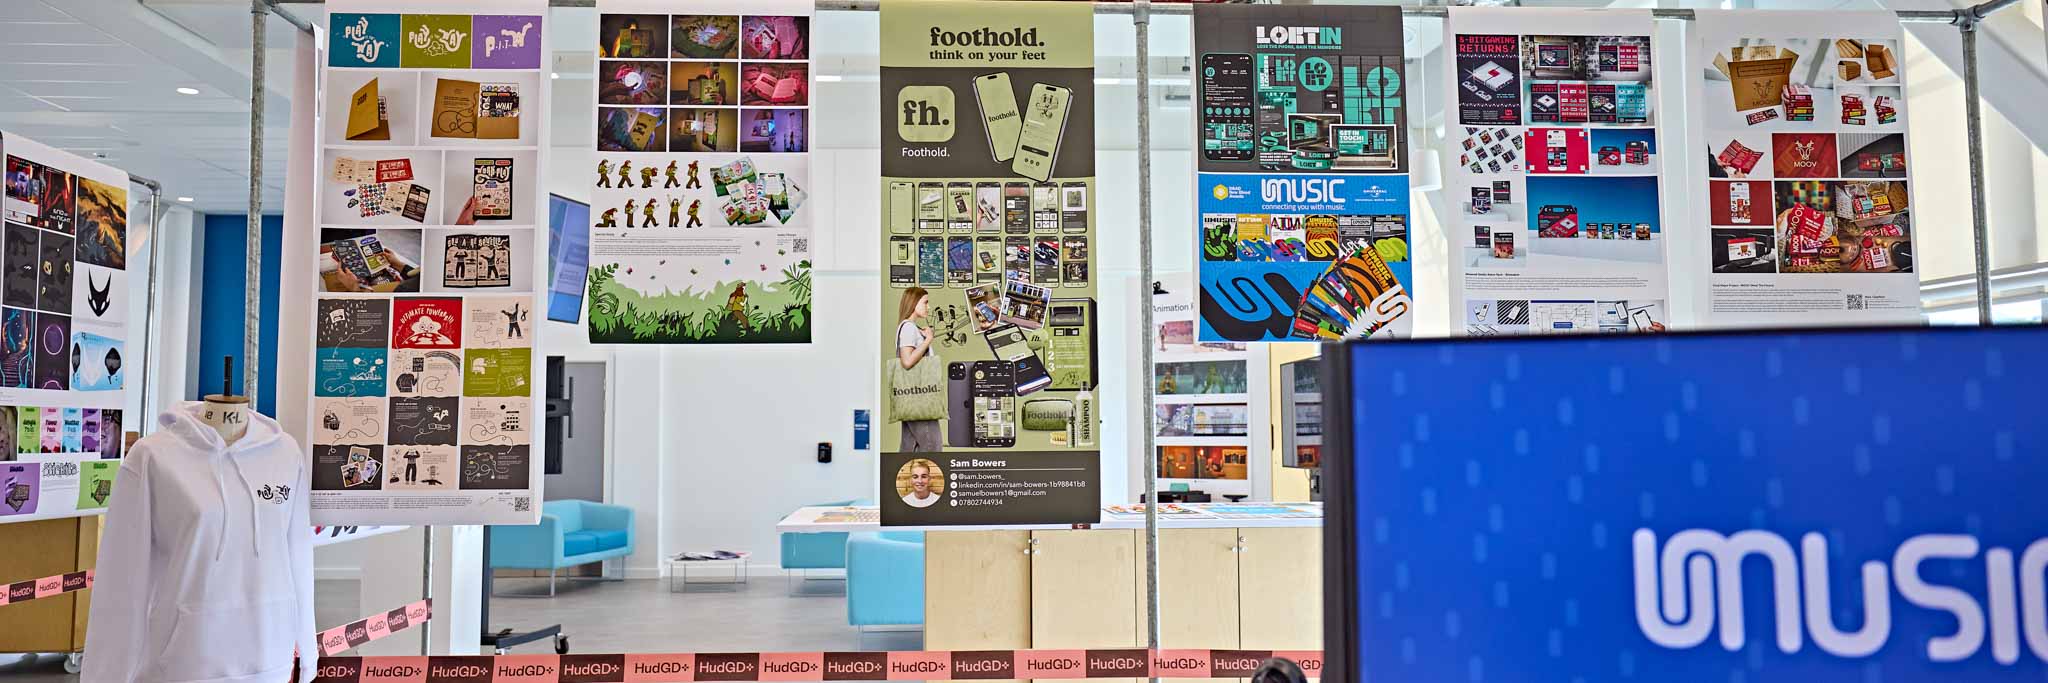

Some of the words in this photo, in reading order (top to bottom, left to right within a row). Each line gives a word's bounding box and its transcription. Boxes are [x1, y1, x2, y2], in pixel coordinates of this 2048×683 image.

[930, 27, 1045, 47] foothold.
[929, 50, 963, 60] think
[968, 52, 984, 60] on
[988, 52, 1018, 62] your
[1022, 50, 1046, 60] feet
[903, 100, 950, 126] fh.
[989, 111, 1018, 123] foothold.
[902, 147, 950, 157] Foothold.
[1261, 204, 1297, 212] connecting
[893, 384, 941, 397] foothold.
[950, 459, 970, 468] Sam
[971, 459, 1006, 468] Bowers
